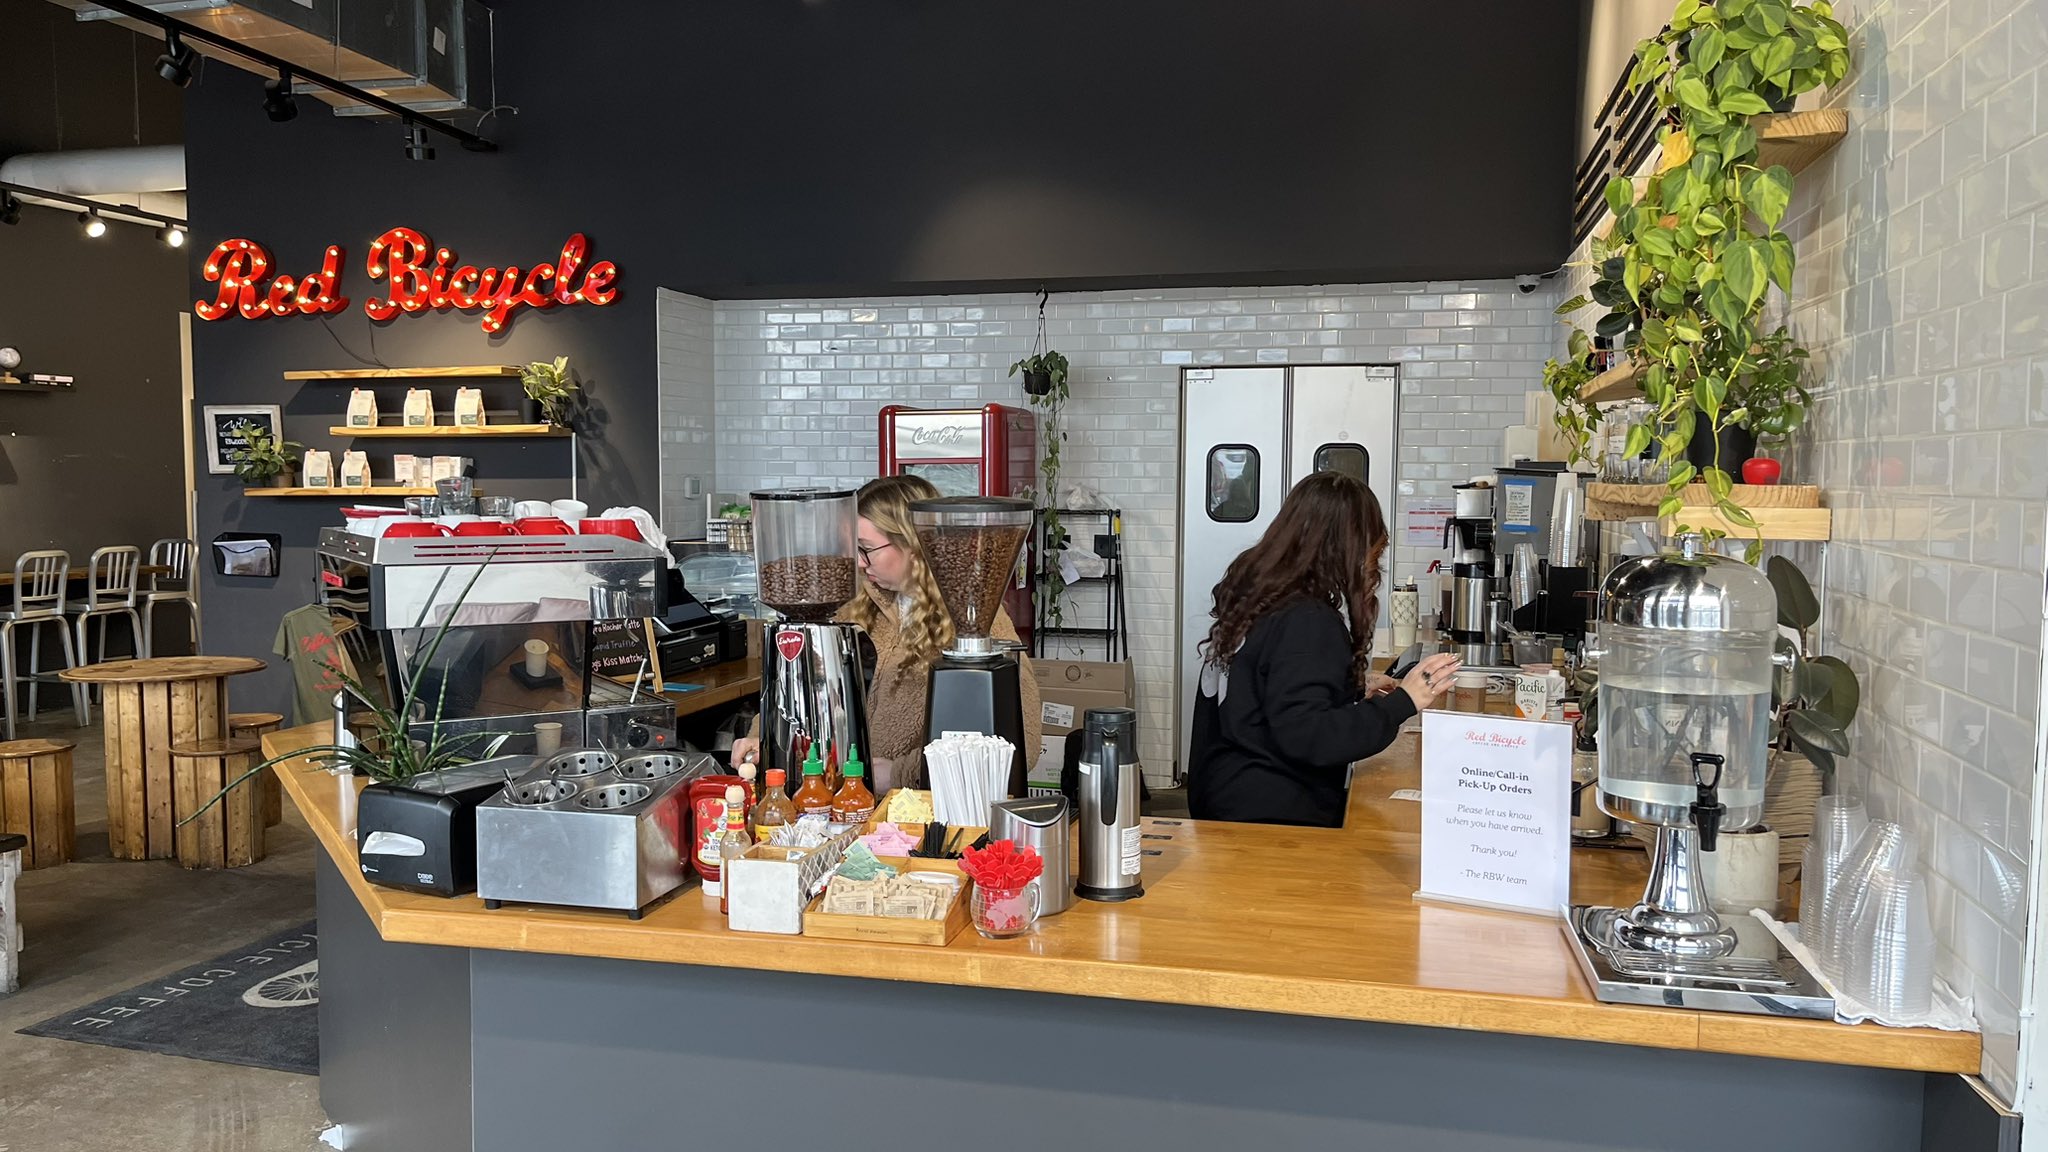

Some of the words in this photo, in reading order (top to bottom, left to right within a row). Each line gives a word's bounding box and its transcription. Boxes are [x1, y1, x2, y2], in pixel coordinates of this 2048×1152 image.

[195, 238, 346, 321] Red
[365, 227, 619, 333] Bicycle
[610, 640, 636, 649] Truffle
[603, 657, 618, 667] Kiss
[1516, 677, 1546, 693] Pacific
[1464, 730, 1487, 742] Red
[1489, 732, 1527, 746] Bicycle
[1461, 766, 1529, 781] Online/Call-in
[1458, 778, 1496, 792] Pick-Up
[1499, 783, 1532, 795] Orders
[1457, 804, 1483, 816] Please
[1484, 807, 1495, 816] let
[1496, 810, 1507, 818] us
[1508, 809, 1532, 821] know
[1446, 816, 1469, 826] when
[1470, 821, 1486, 832] you
[1488, 820, 1509, 831] have
[1510, 824, 1544, 836] arrived.
[1470, 844, 1497, 855] Thank
[1498, 848, 1518, 858] you!
[1465, 869, 1481, 879] The
[1482, 871, 1505, 882] RBW
[1506, 875, 1528, 885] team
[72, 968, 237, 1029] COFFEE
